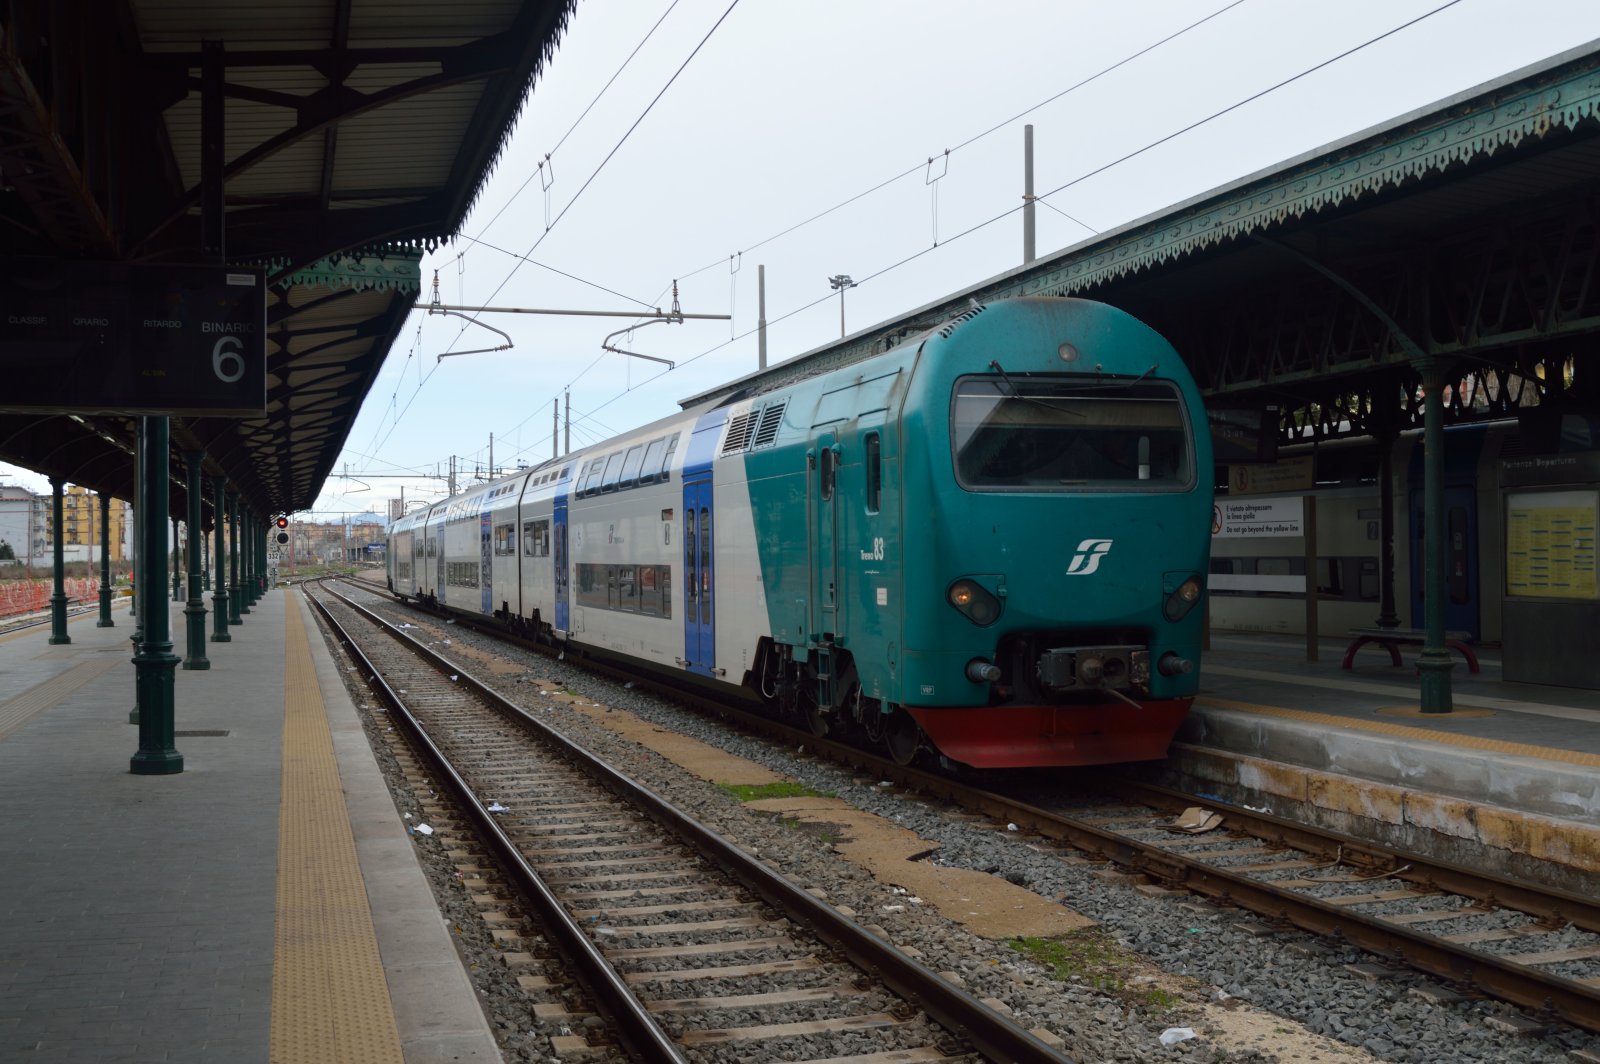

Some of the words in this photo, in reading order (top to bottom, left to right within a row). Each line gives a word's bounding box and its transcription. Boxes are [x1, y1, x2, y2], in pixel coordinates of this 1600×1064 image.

[72, 317, 109, 327] ORARIO
[143, 319, 182, 329] RITARDO
[201, 321, 256, 334] BINARIO
[212, 335, 245, 383] 6
[1245, 504, 1272, 513] oltrepassare
[1231, 512, 1242, 520] linea
[1248, 525, 1265, 534] beyond
[1265, 524, 1273, 532] the
[1273, 524, 1289, 534] yellow
[1289, 524, 1299, 532] line
[860, 549, 874, 561] Treno
[874, 536, 884, 561] 83
